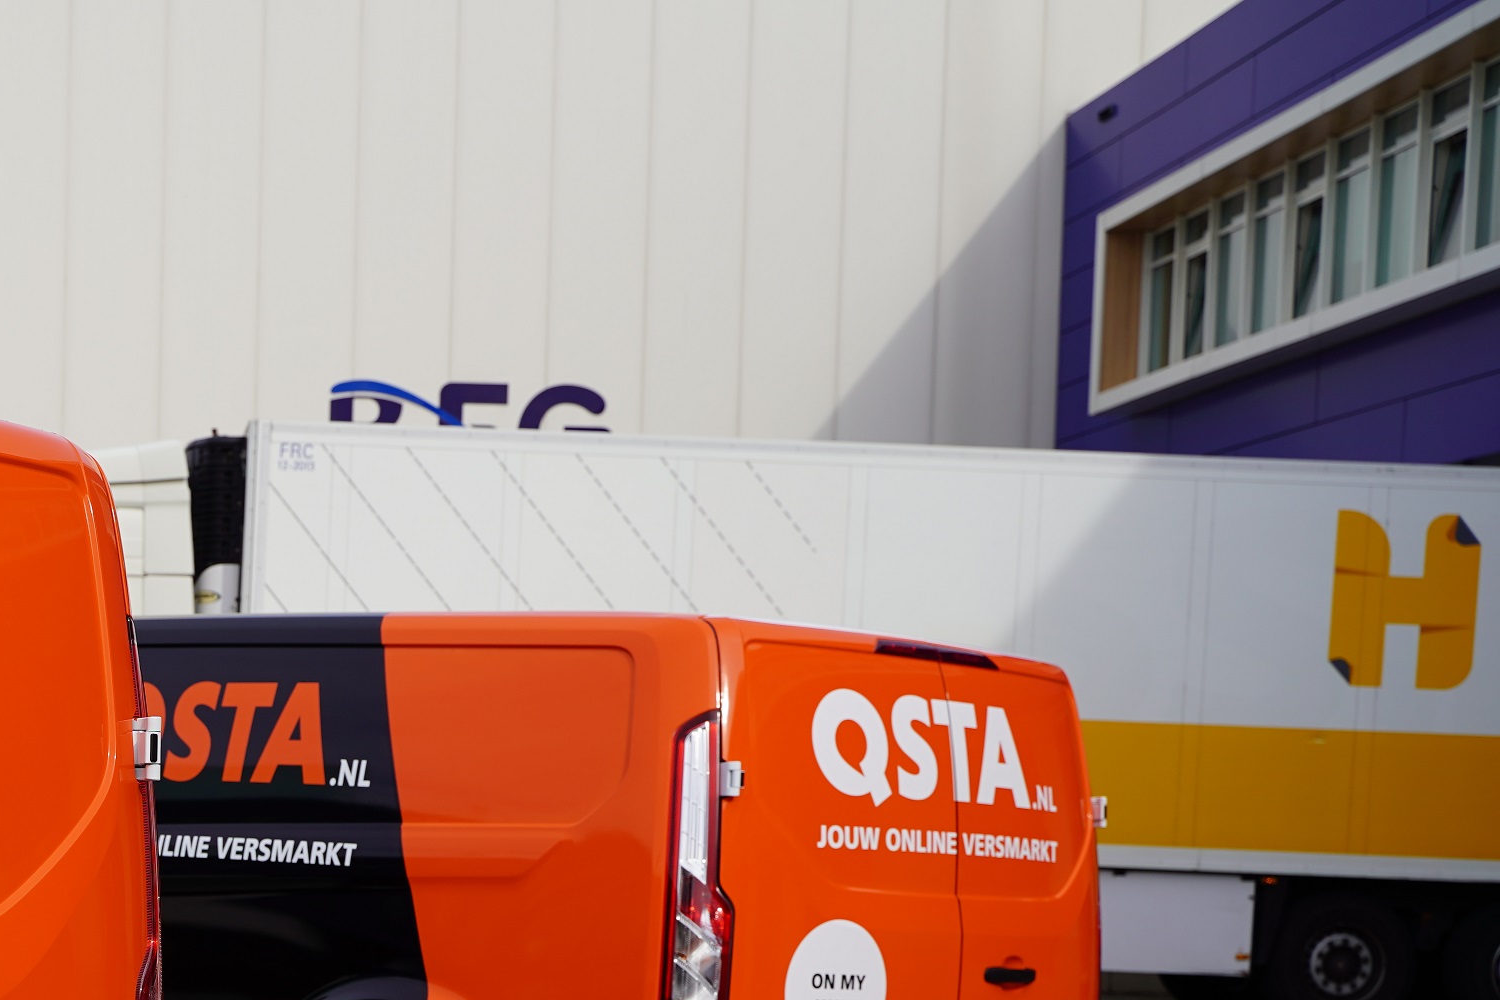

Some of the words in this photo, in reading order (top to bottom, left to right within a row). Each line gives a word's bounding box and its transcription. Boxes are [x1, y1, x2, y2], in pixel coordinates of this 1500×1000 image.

[278, 442, 315, 460] FRC
[158, 834, 211, 858] LINE
[217, 836, 357, 867] VERSMARKT
[817, 824, 880, 850] JOUW
[885, 828, 957, 855] ONLINE
[963, 832, 1058, 863] VERSMARKT
[811, 973, 835, 989] ON
[841, 974, 866, 990] MY
